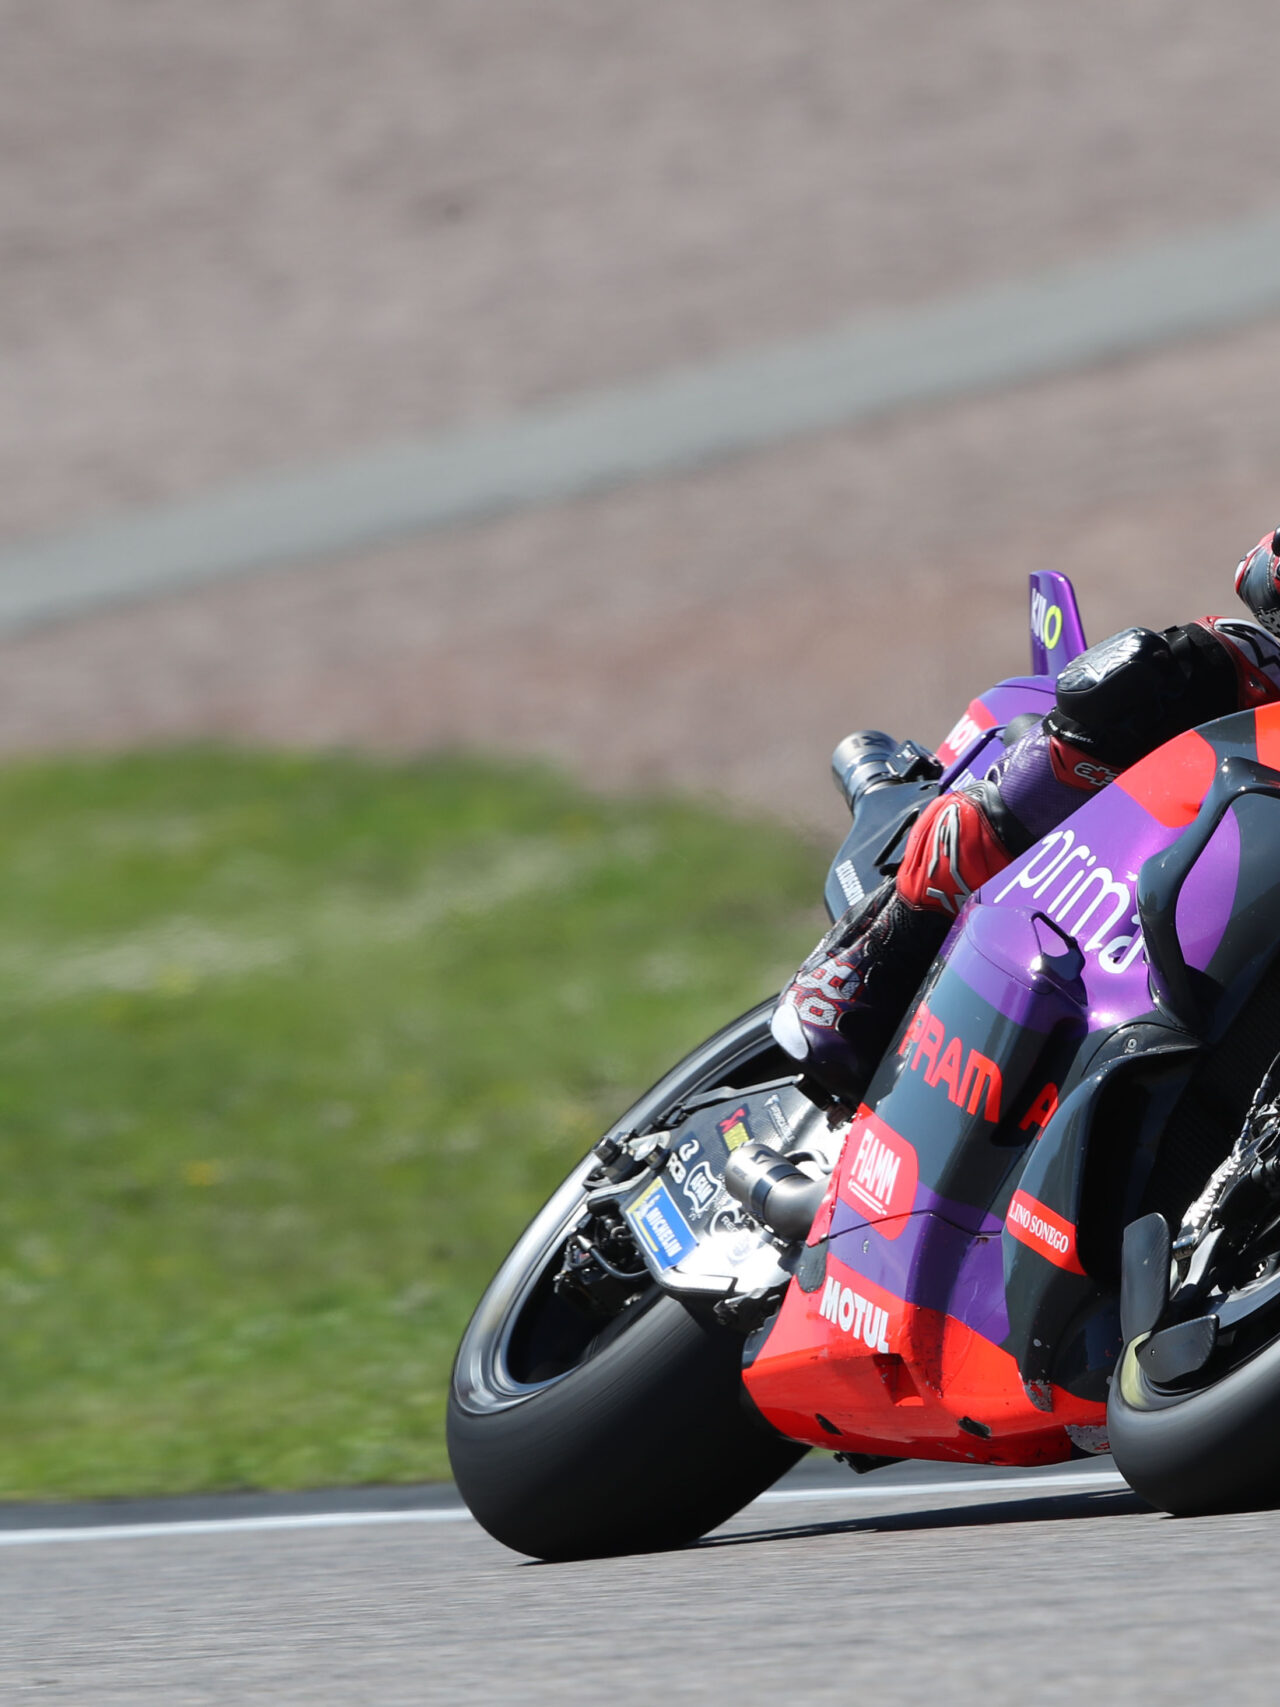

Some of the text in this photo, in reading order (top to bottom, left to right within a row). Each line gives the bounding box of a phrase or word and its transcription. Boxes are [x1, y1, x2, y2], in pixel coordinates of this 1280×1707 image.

[994, 828, 1146, 975] prima
[898, 1001, 1059, 1134] PRAMA
[851, 1128, 902, 1206] FIAMM
[645, 1206, 683, 1258] MICHELIN
[1008, 1198, 1069, 1254] LINO SONEGO
[819, 1276, 891, 1354] MOTUL
